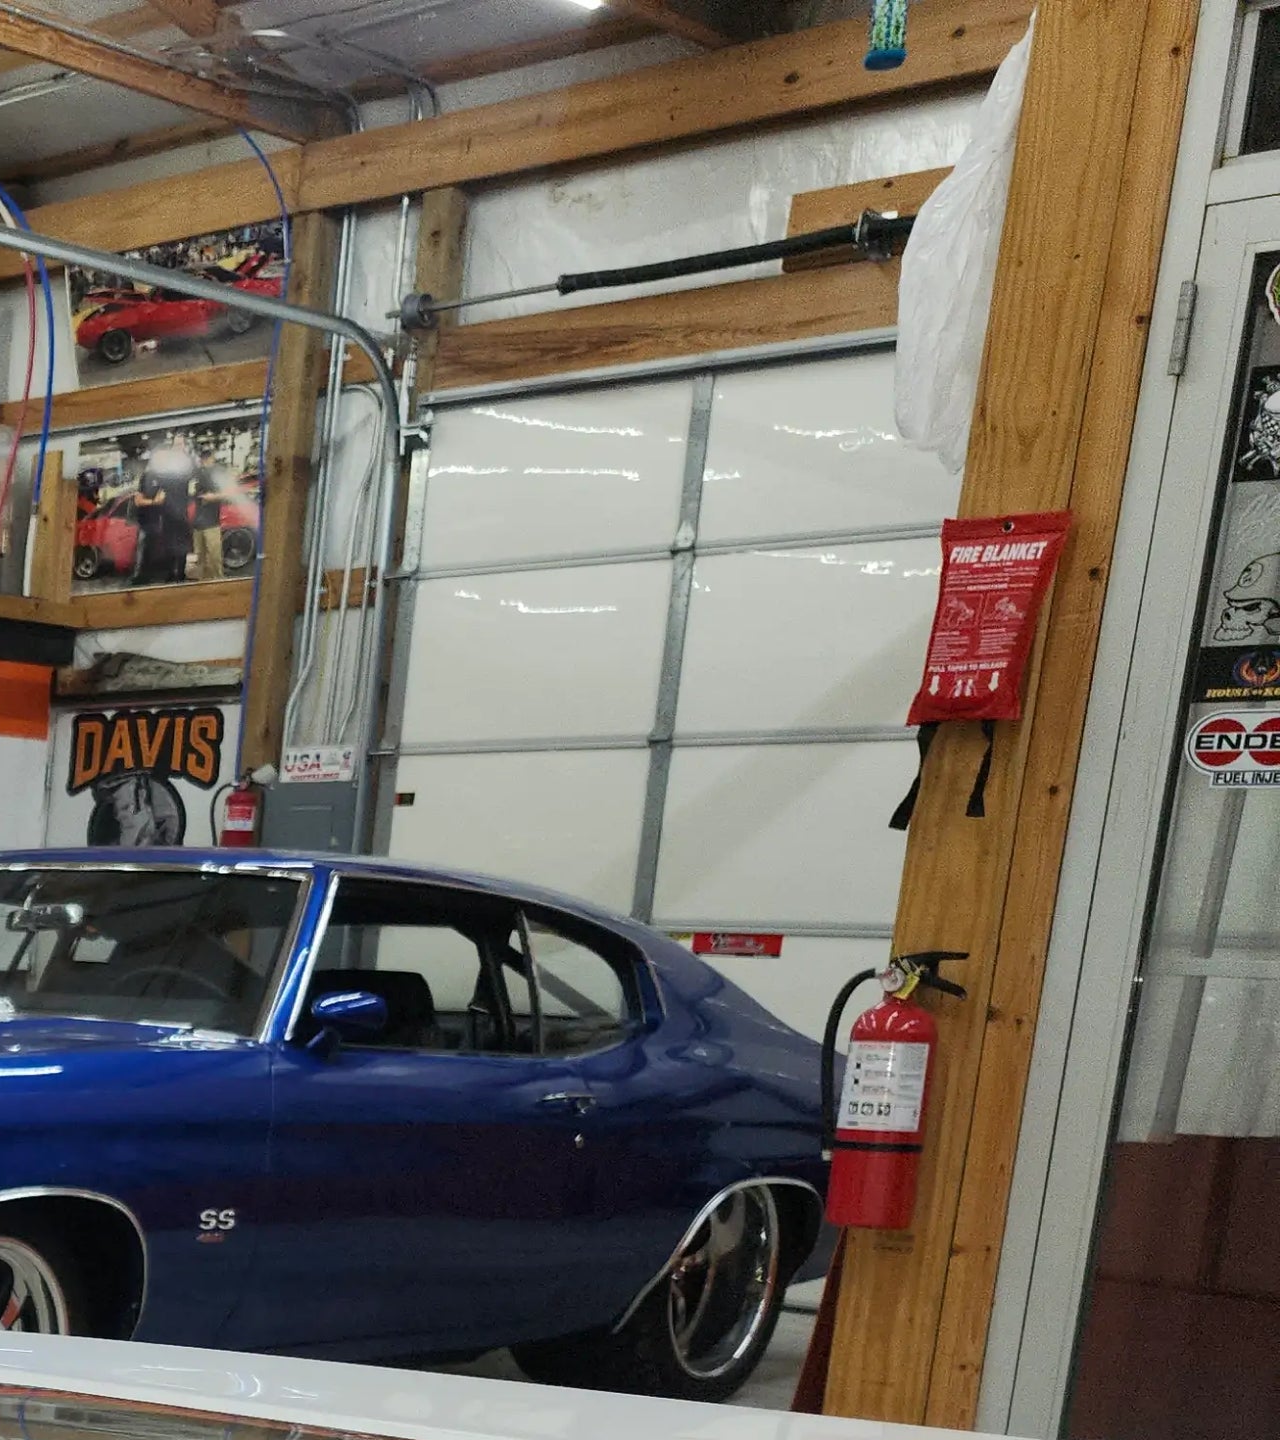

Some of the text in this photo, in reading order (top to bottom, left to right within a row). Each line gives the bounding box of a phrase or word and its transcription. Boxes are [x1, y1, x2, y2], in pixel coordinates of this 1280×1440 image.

[950, 540, 1048, 564] FIRE BLANKET
[1205, 686, 1250, 698] HOUSE
[72, 714, 218, 789] DAVIS
[284, 752, 321, 773] USA
[1215, 772, 1248, 785] FUEL
[199, 1209, 236, 1230] SS
